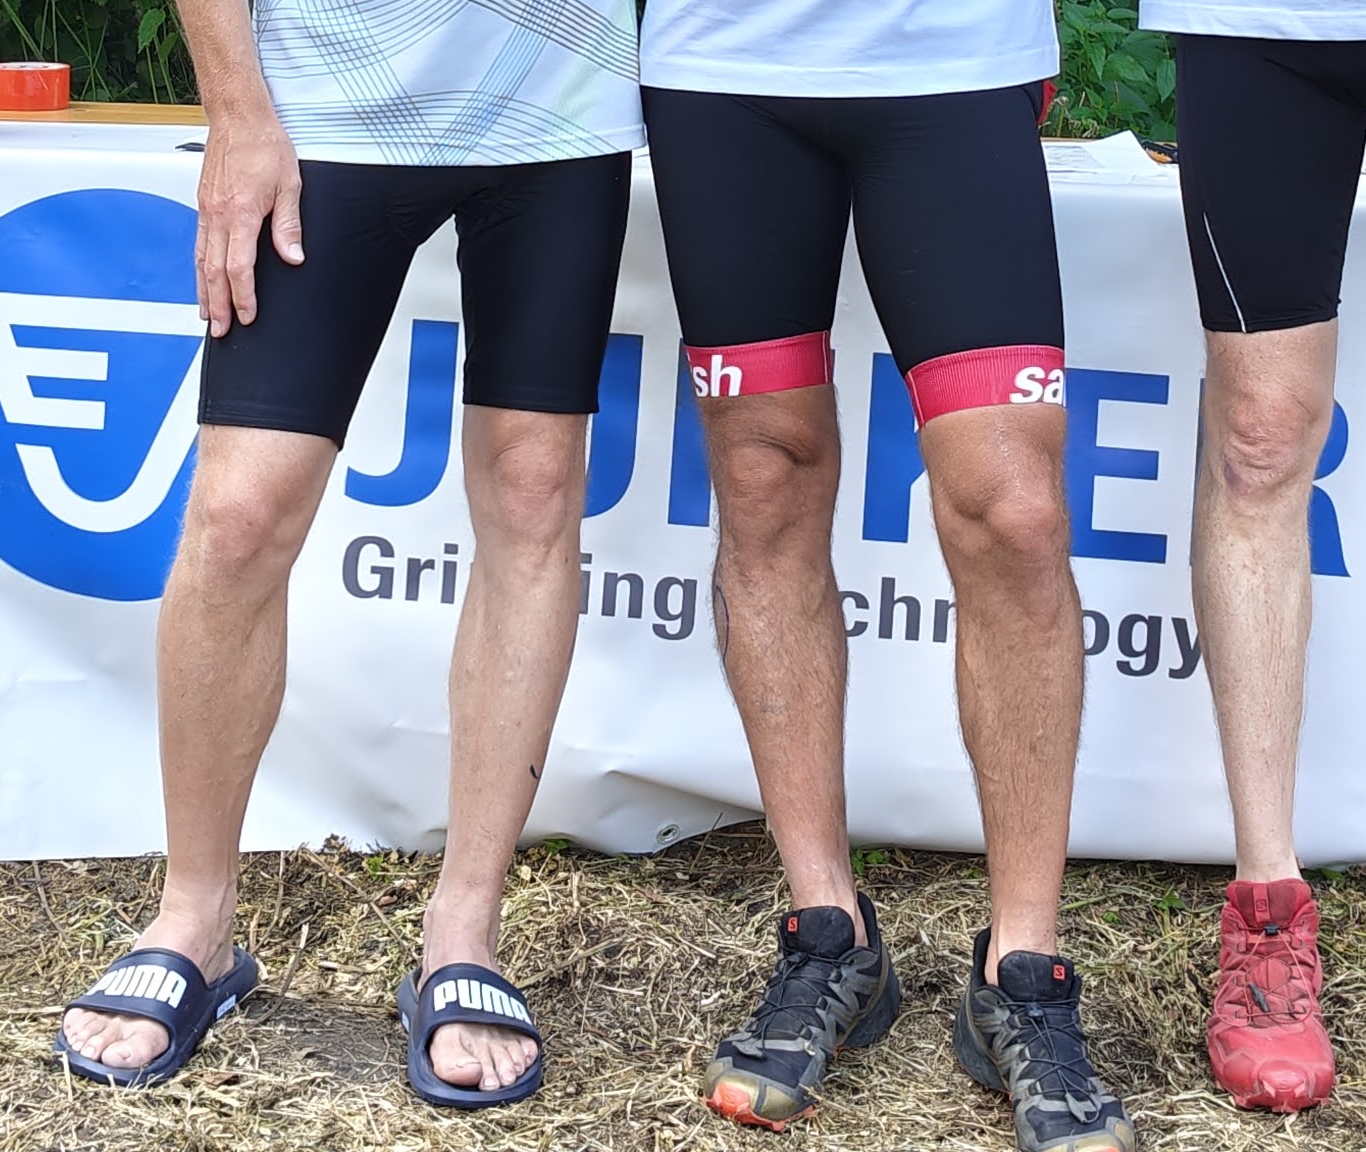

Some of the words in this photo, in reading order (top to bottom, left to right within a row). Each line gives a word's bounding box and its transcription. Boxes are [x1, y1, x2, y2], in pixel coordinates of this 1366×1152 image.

[690, 354, 742, 397] sh
[1009, 366, 1066, 407] sa
[341, 535, 698, 641] Griing
[838, 576, 1203, 680] chogy
[84, 964, 188, 1009] PUMA
[433, 978, 533, 1027] PUMA
